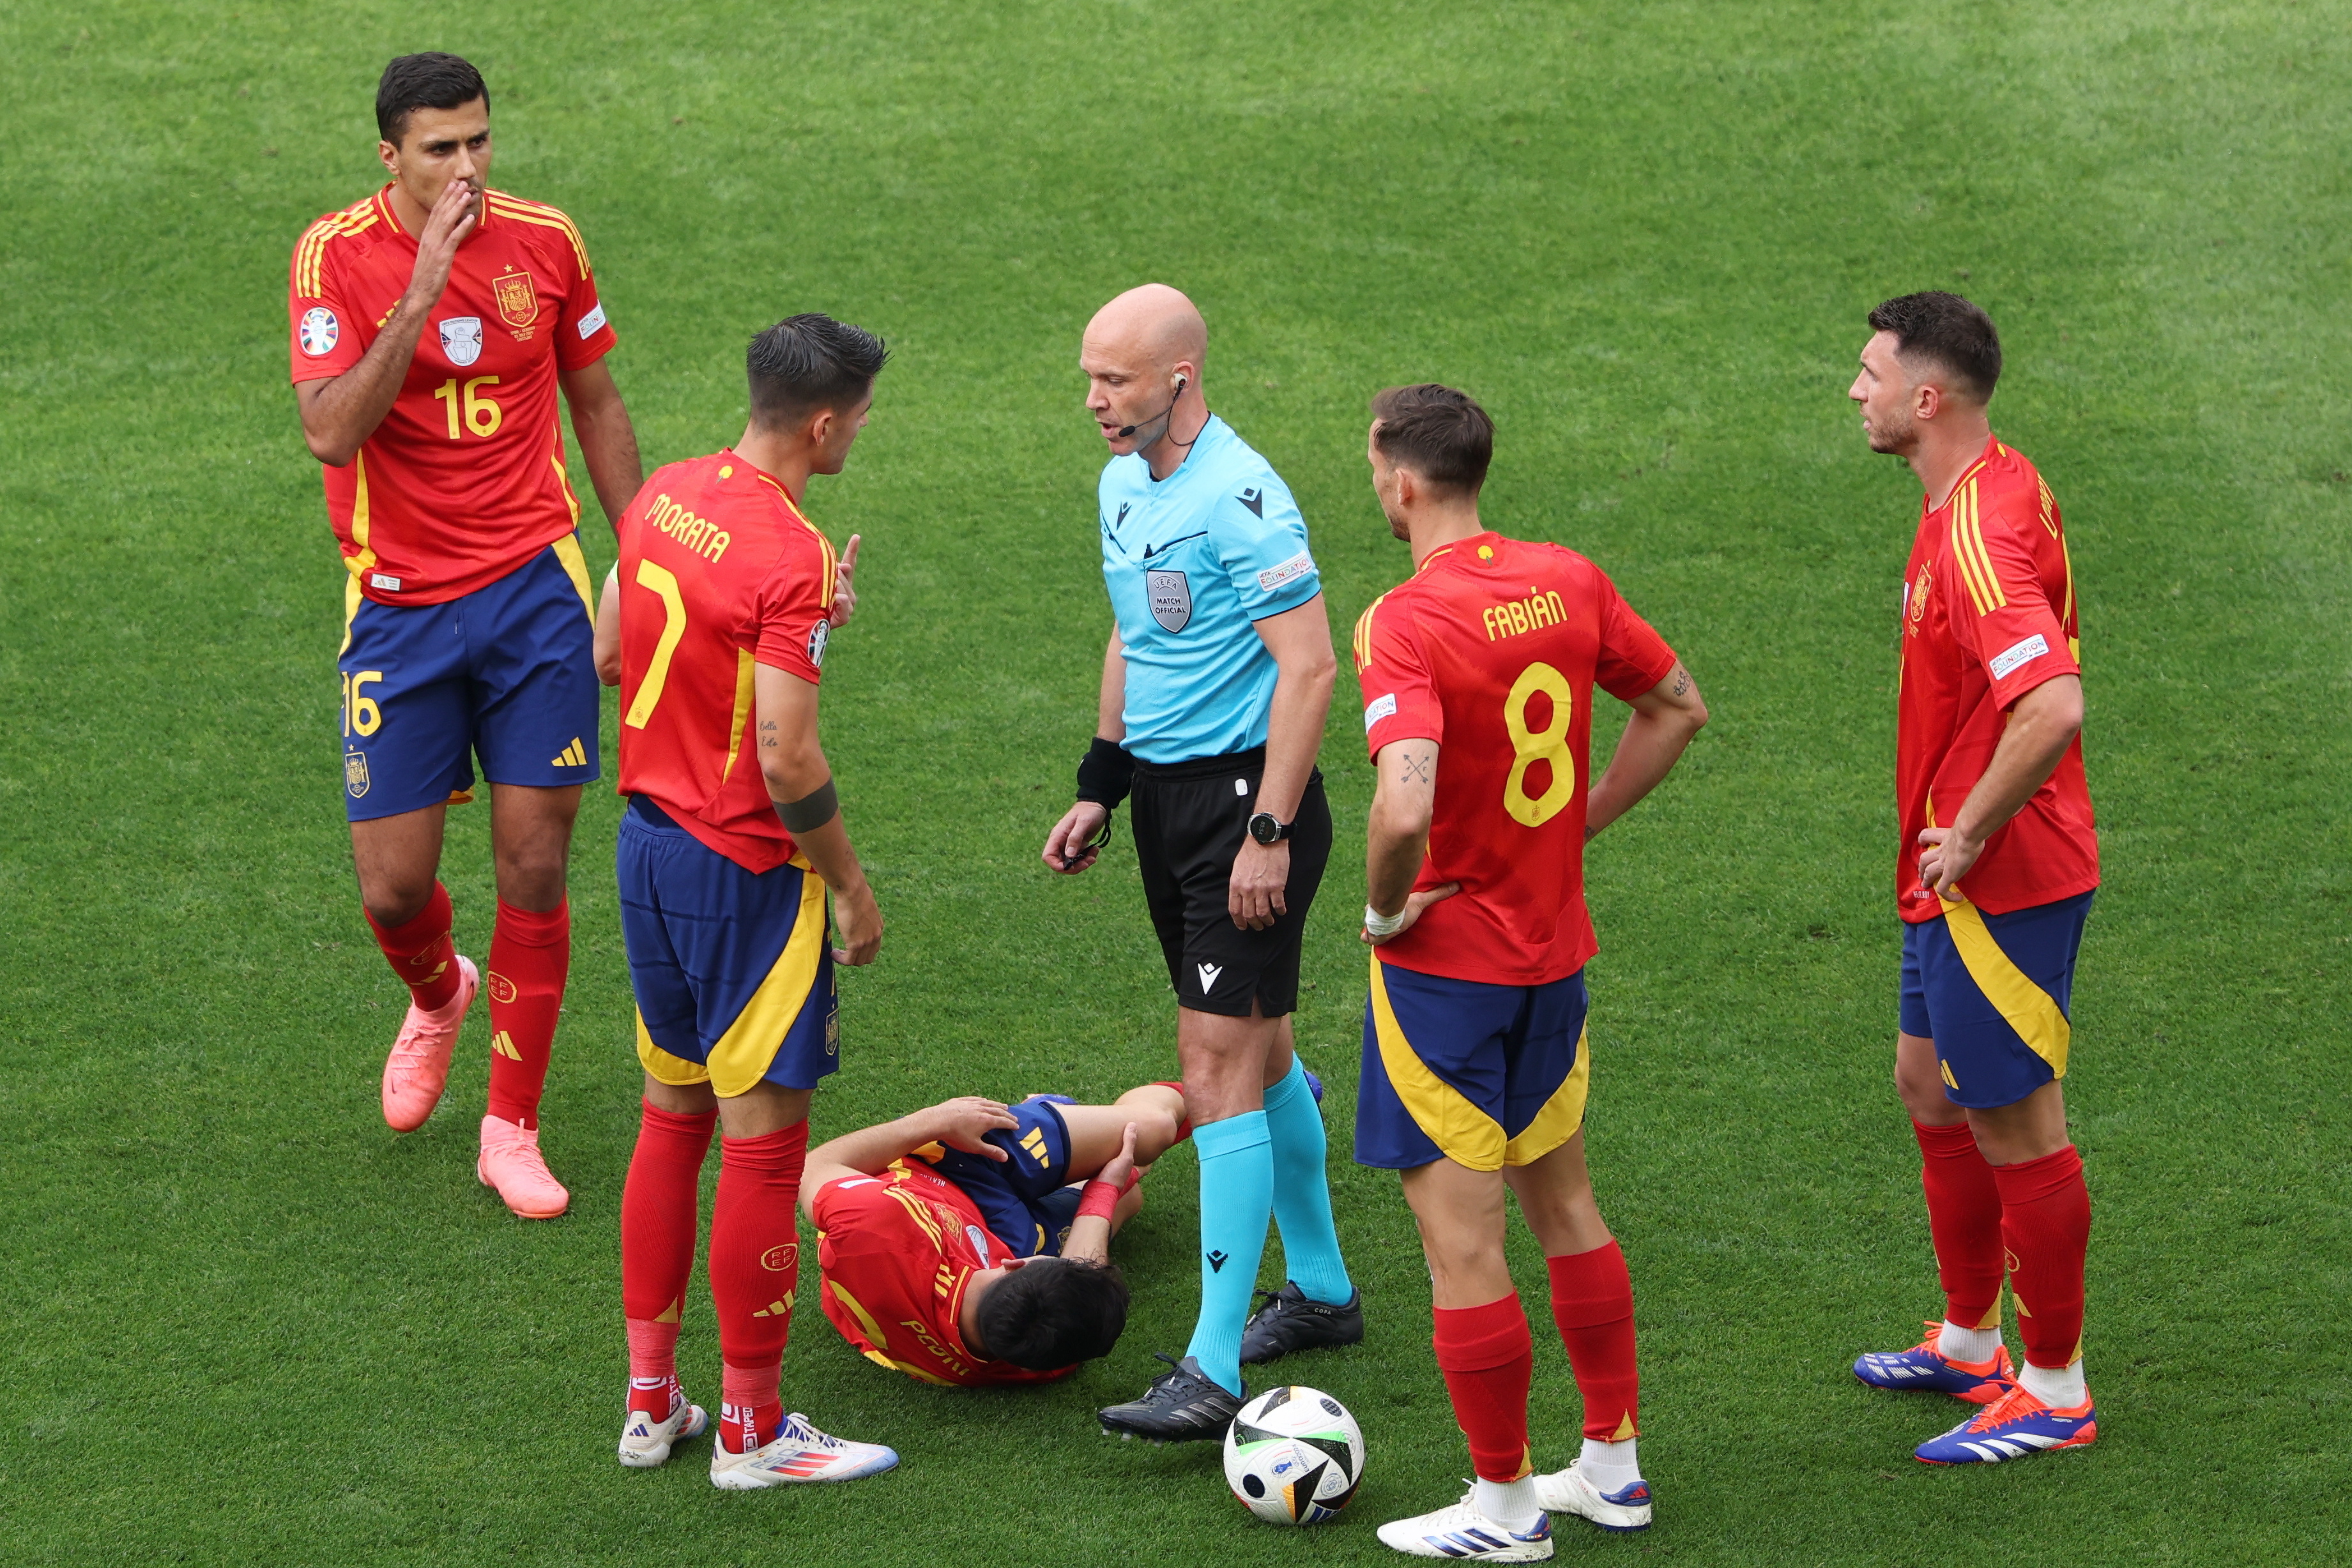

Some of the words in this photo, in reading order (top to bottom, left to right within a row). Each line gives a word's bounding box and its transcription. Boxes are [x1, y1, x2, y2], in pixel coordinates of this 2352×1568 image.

[434, 376, 502, 439] 16
[645, 493, 731, 564] MORATA
[1154, 578, 1177, 590] UEFA
[1482, 586, 1568, 642] FABIÁN
[625, 558, 687, 730] 7
[1993, 640, 2045, 674] FOUNDATION
[341, 671, 383, 737] 16
[760, 720, 777, 731] Bella
[761, 736, 778, 747] Edo
[1504, 661, 1575, 828] 8
